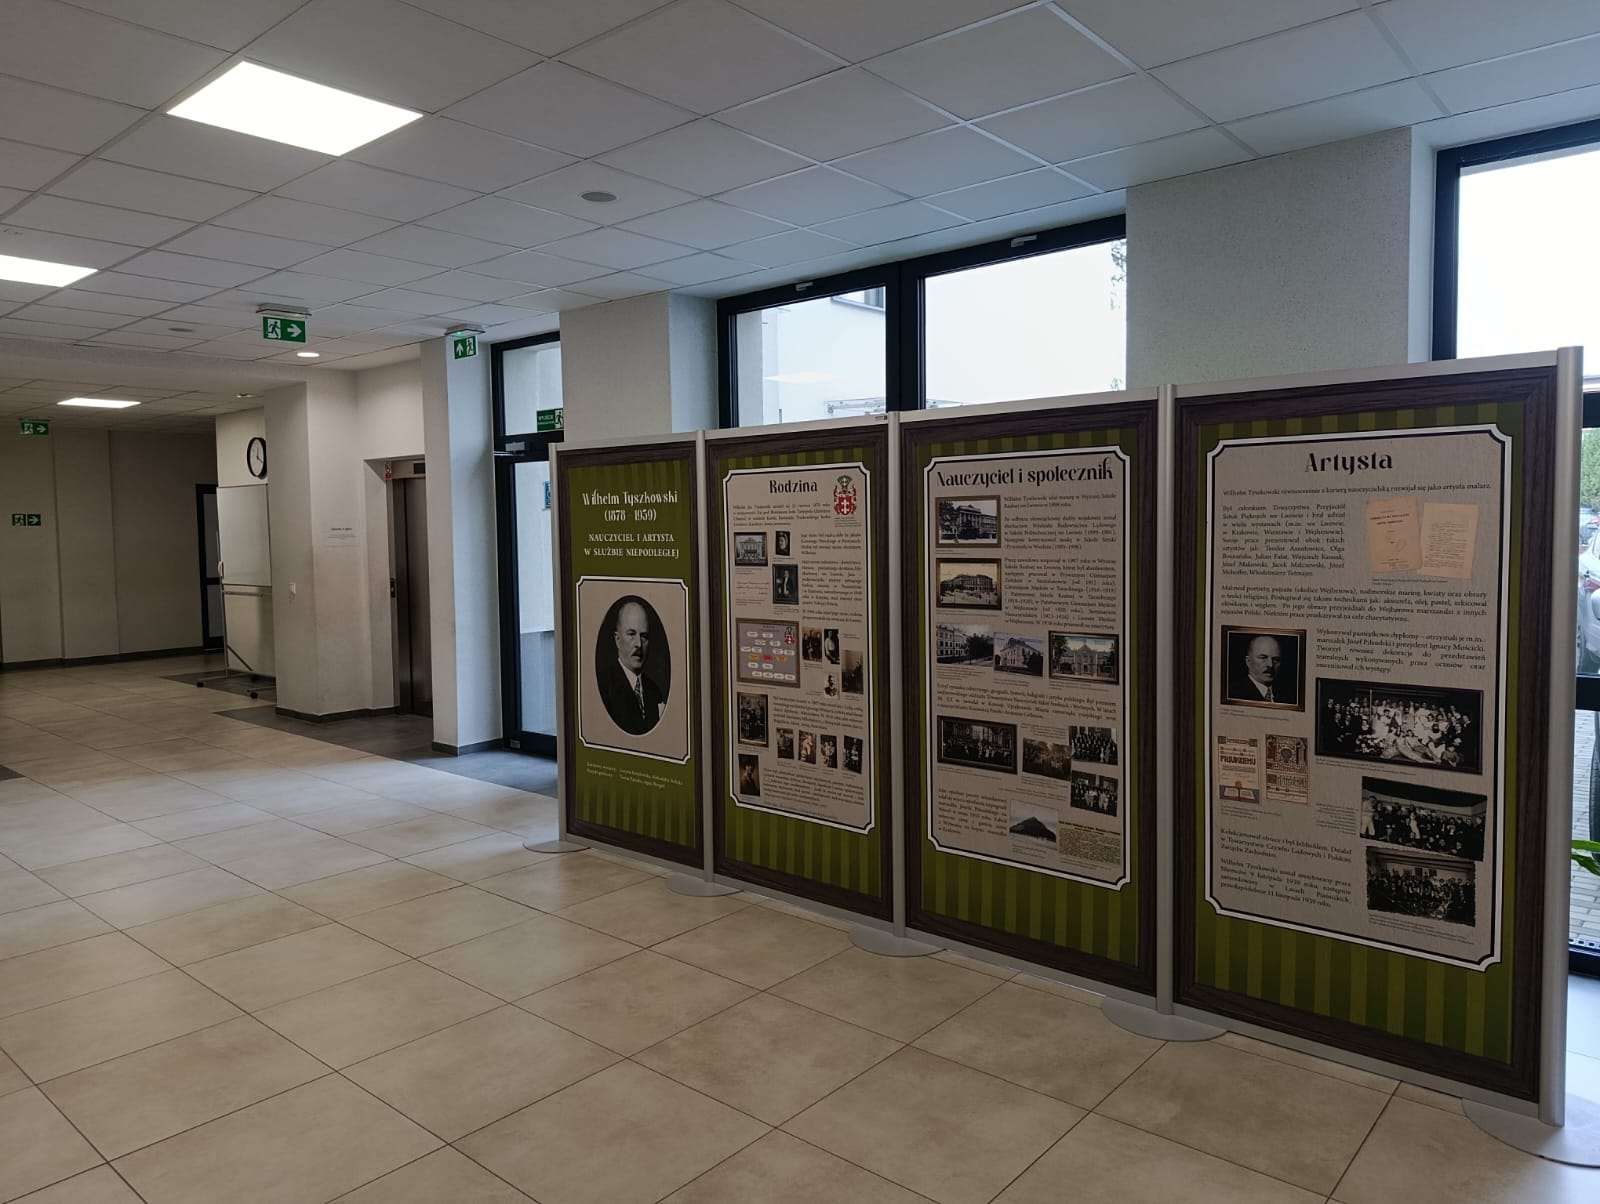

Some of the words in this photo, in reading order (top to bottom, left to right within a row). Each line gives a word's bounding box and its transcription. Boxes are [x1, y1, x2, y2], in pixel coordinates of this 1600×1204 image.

[1305, 452, 1393, 475] Artysta
[937, 469, 1014, 487] Nauczyciel
[1019, 468, 1023, 483] i
[769, 480, 818, 494] Rodzina
[582, 489, 620, 505] Wilhelm
[623, 490, 678, 506] Tyszkowski
[589, 534, 634, 542] NAUCZYCIEL
[637, 534, 640, 542] I
[643, 534, 674, 542] ARTYSTA
